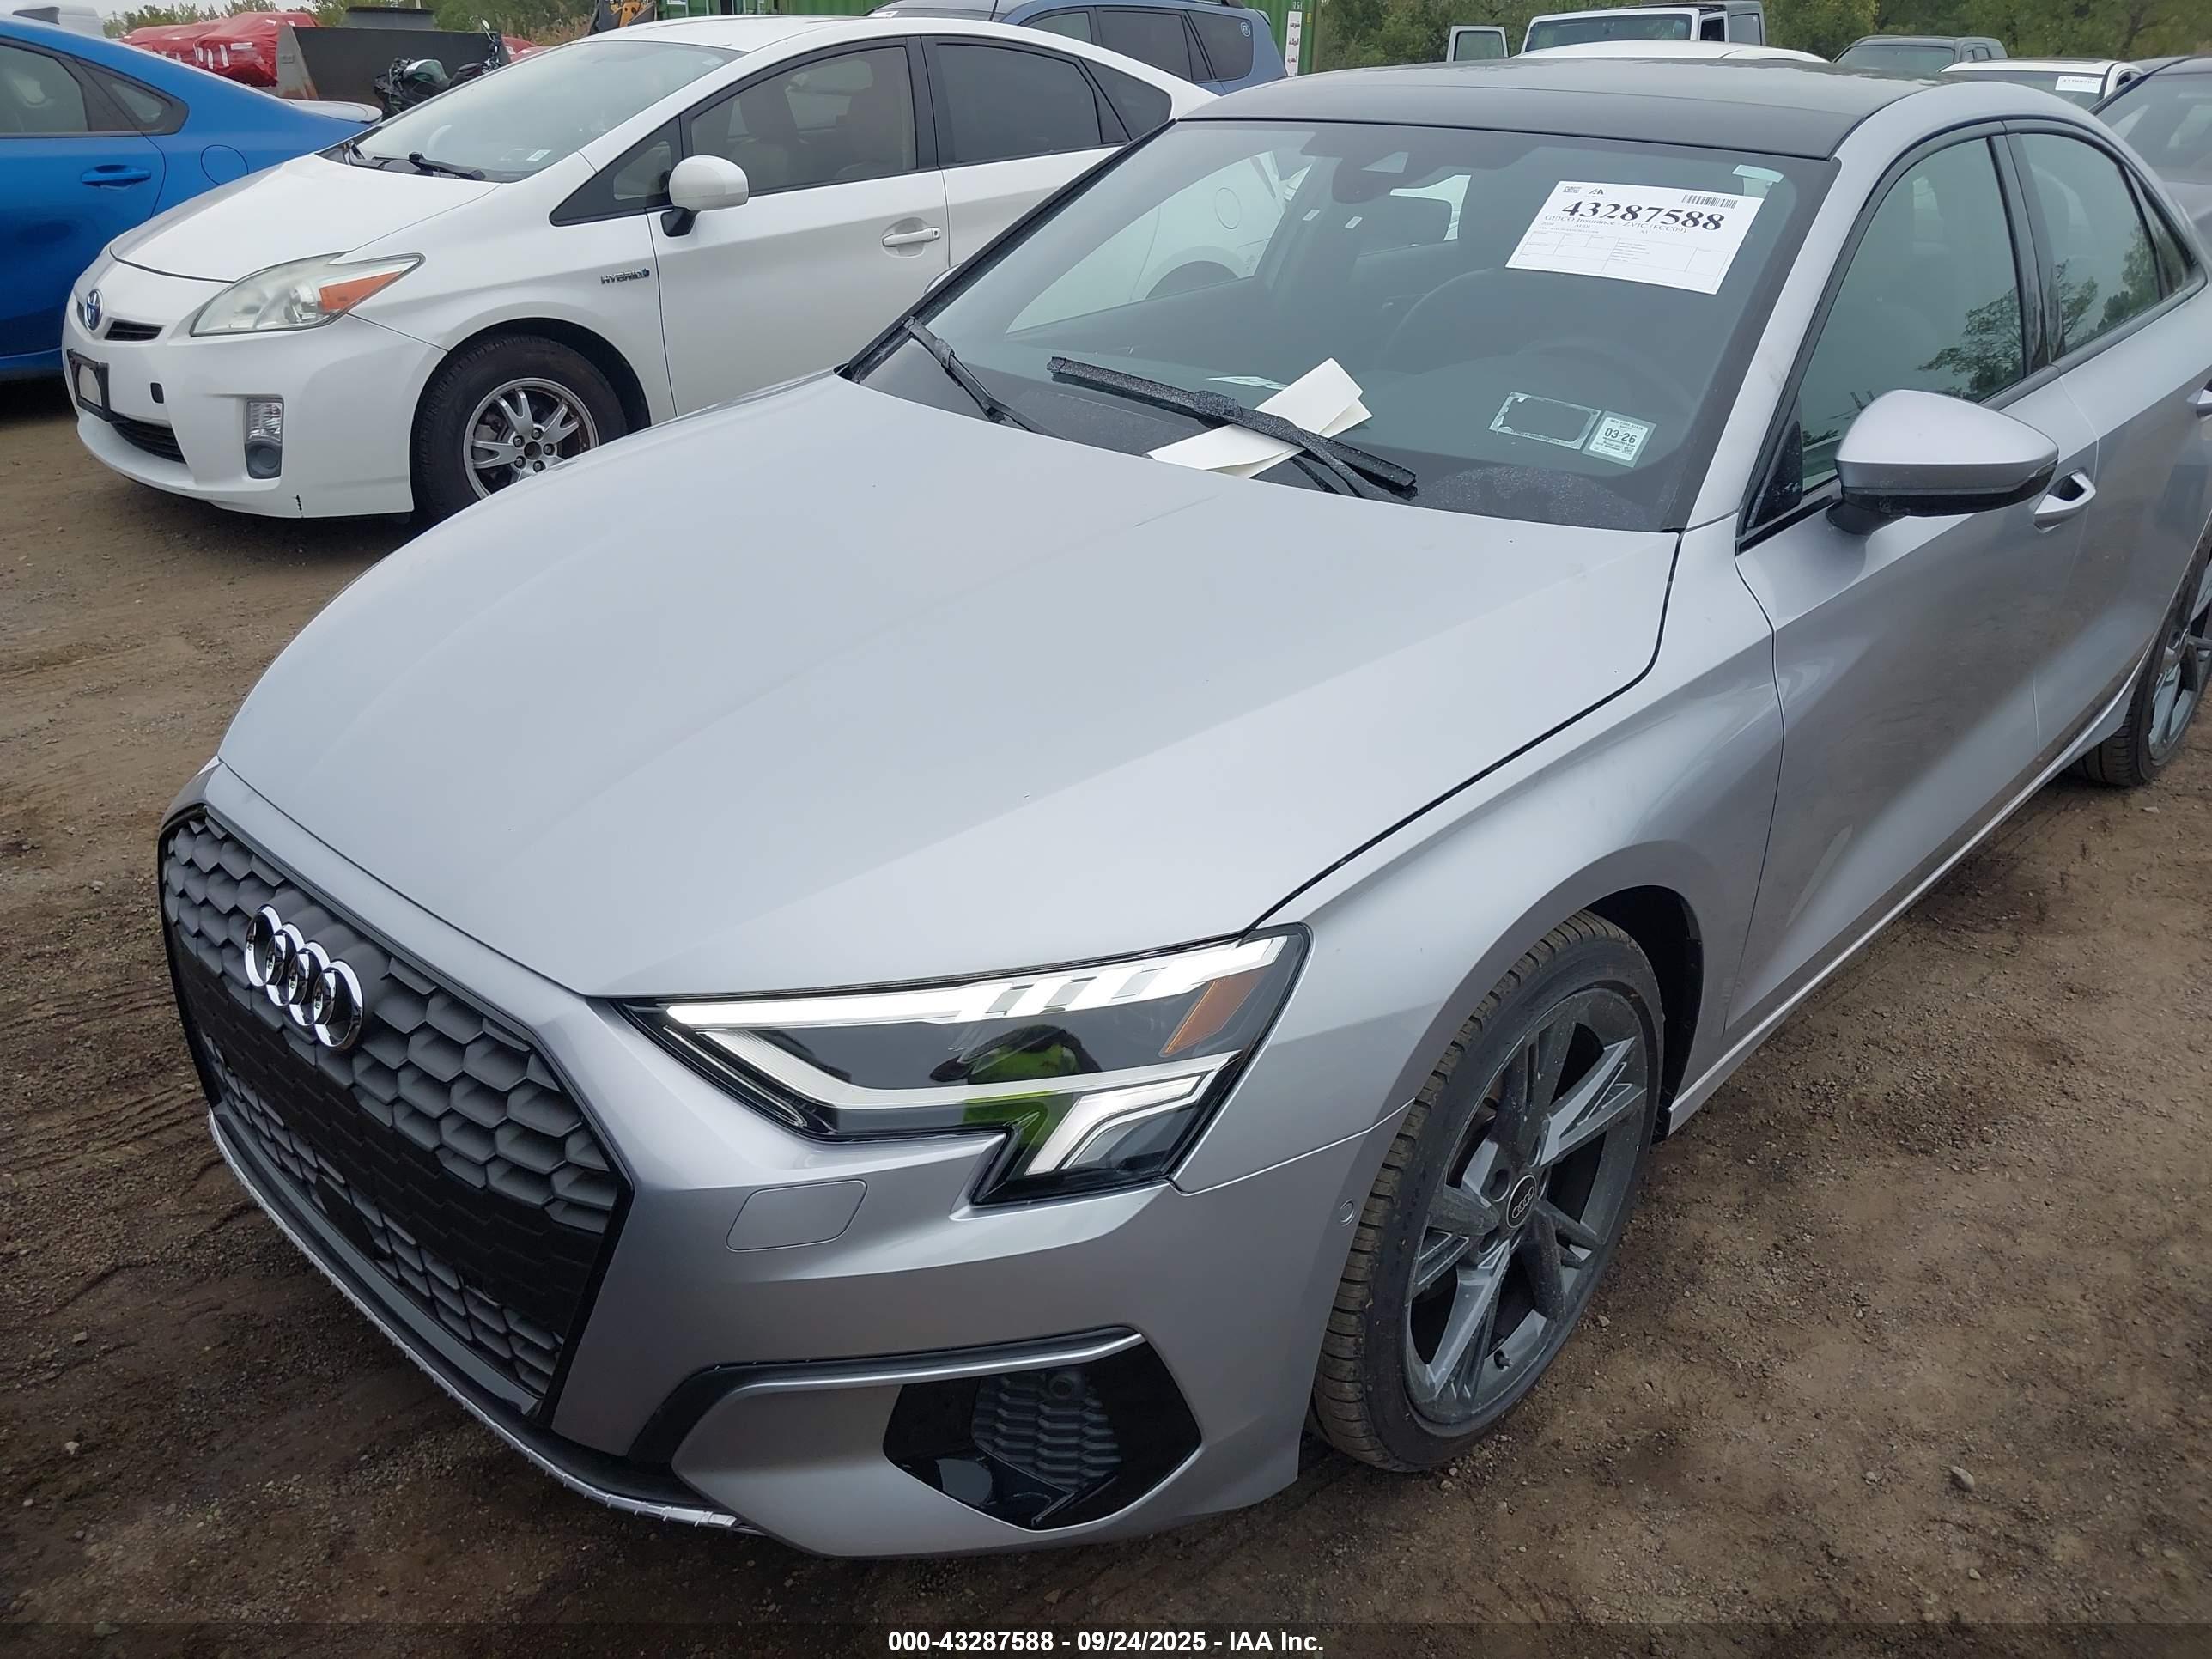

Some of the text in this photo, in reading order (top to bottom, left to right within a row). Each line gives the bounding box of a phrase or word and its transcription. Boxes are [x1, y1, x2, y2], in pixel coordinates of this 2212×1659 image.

[1561, 201, 1724, 230] 43287588
[1577, 216, 1615, 226] Insurance
[601, 271, 642, 285] HYBRID
[1604, 428, 1638, 444] 03-26
